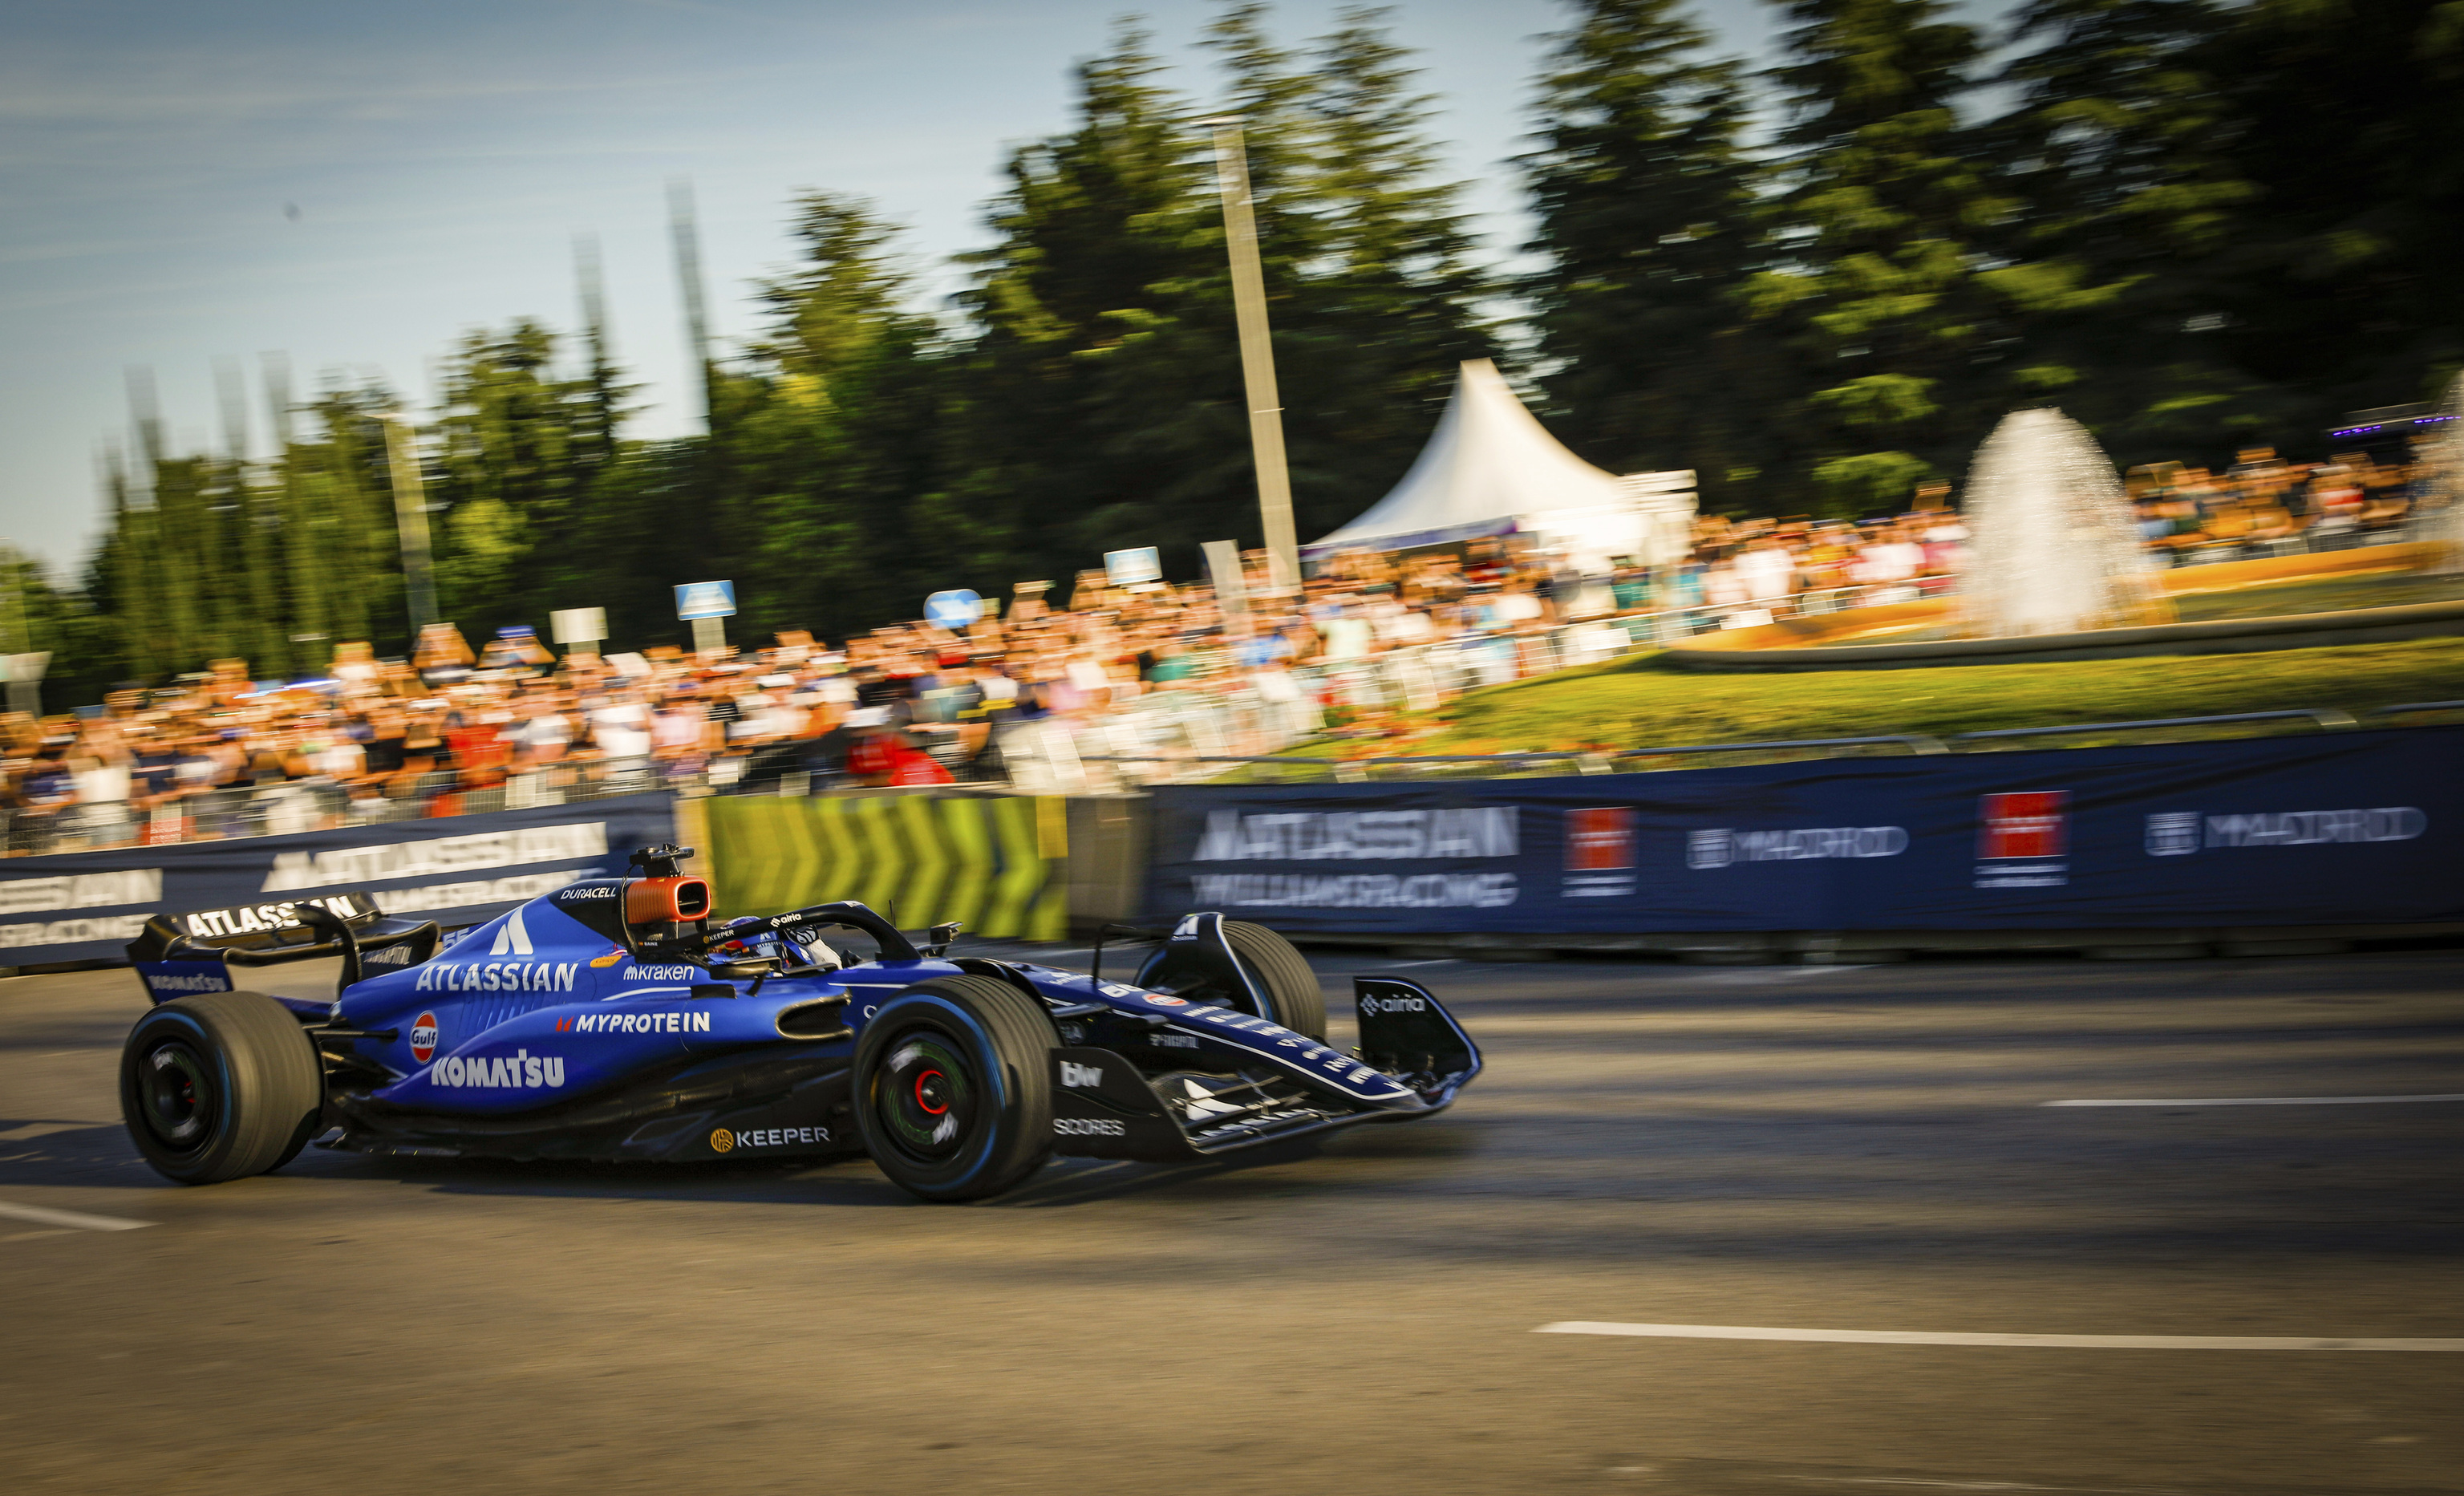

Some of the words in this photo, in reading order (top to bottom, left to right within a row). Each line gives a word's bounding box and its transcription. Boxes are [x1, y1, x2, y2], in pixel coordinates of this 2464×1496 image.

[560, 887, 616, 900] DURACELL
[186, 895, 358, 937] ATLASSN
[780, 913, 802, 924] airia
[709, 930, 735, 942] KEEPER
[148, 973, 227, 991] KOMATSU
[415, 963, 578, 991] ATLASSIAN
[1380, 994, 1425, 1012] airia
[576, 1012, 711, 1033] MYPROTEIN
[411, 1029, 437, 1044] Gulf
[431, 1049, 565, 1088] KOMATSU
[736, 1127, 831, 1148] KEEPER
